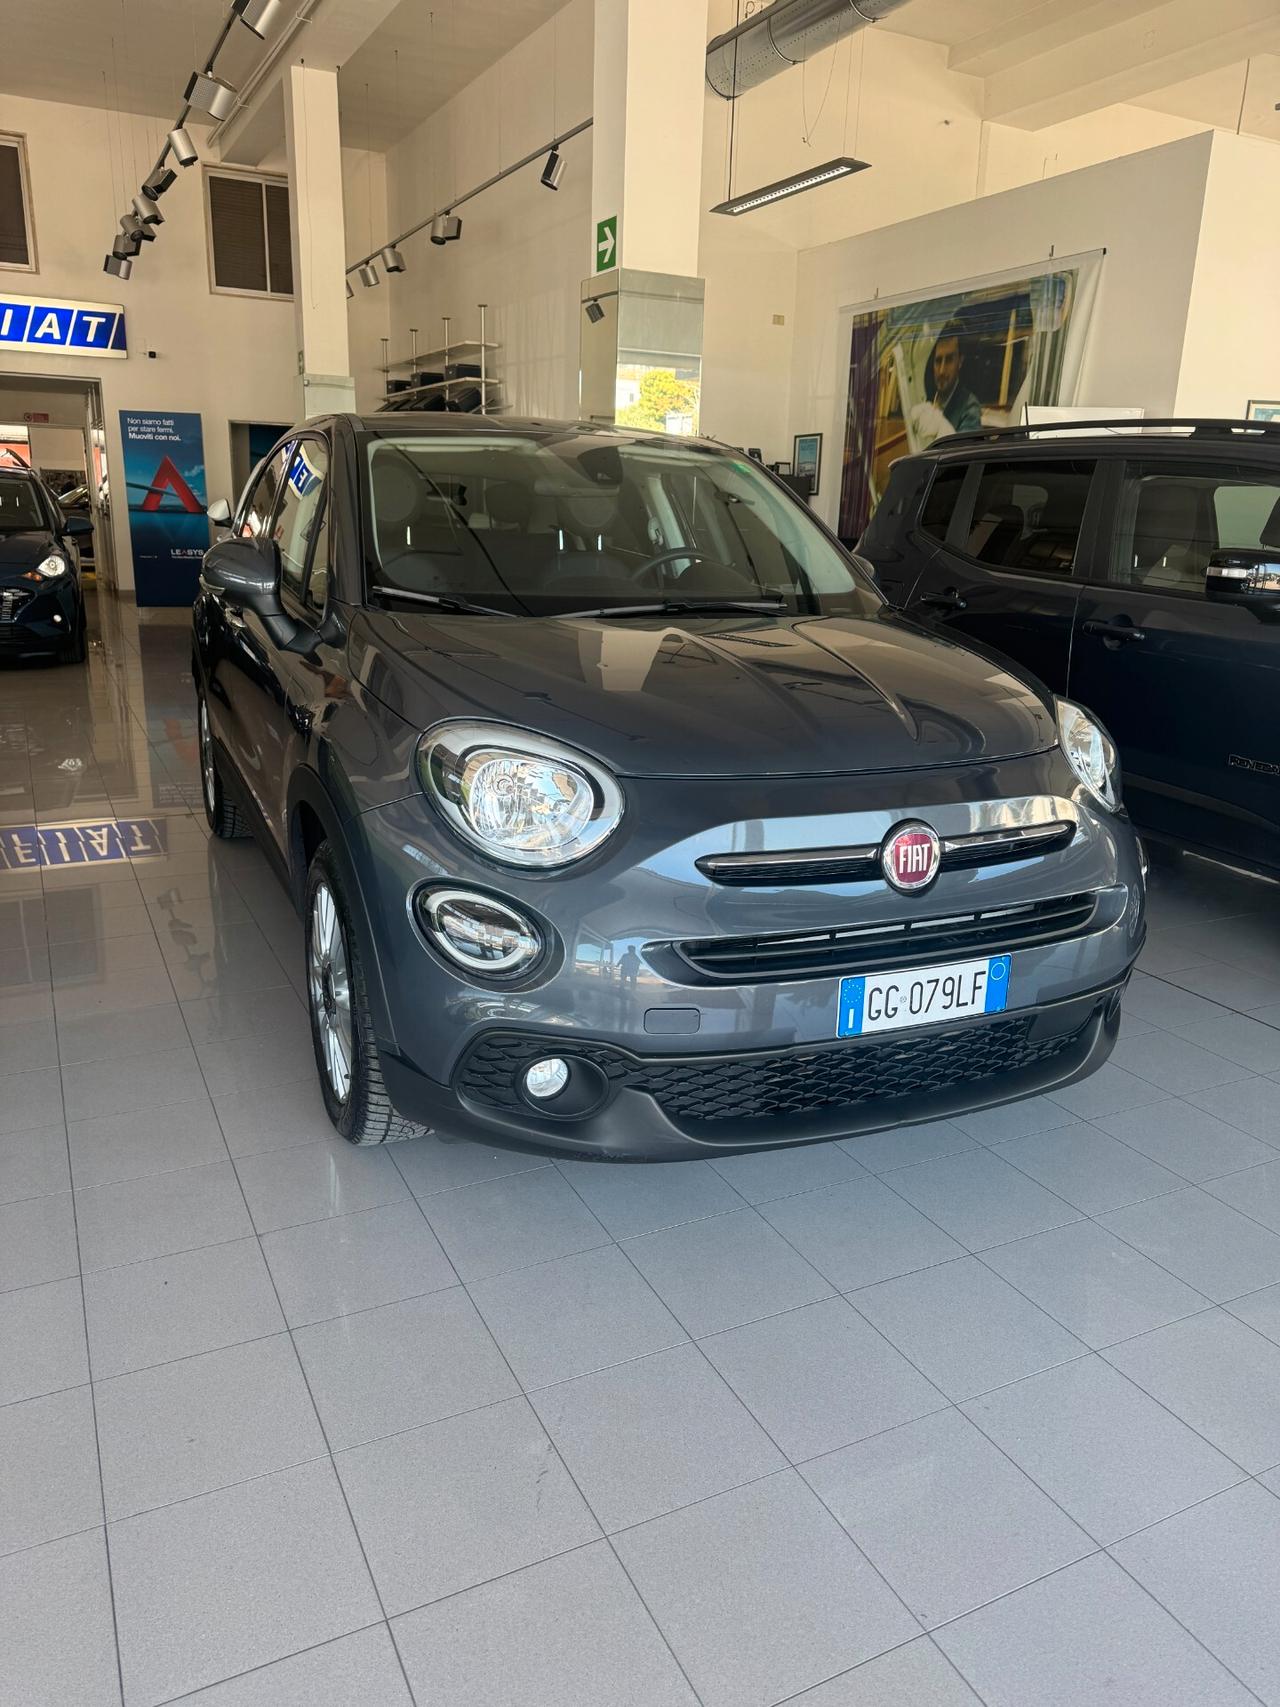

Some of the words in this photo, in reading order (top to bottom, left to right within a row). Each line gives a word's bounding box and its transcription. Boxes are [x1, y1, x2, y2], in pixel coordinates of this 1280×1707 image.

[0, 309, 106, 342] IAT
[1229, 754, 1280, 776] RENEGA
[899, 843, 930, 873] FIAT
